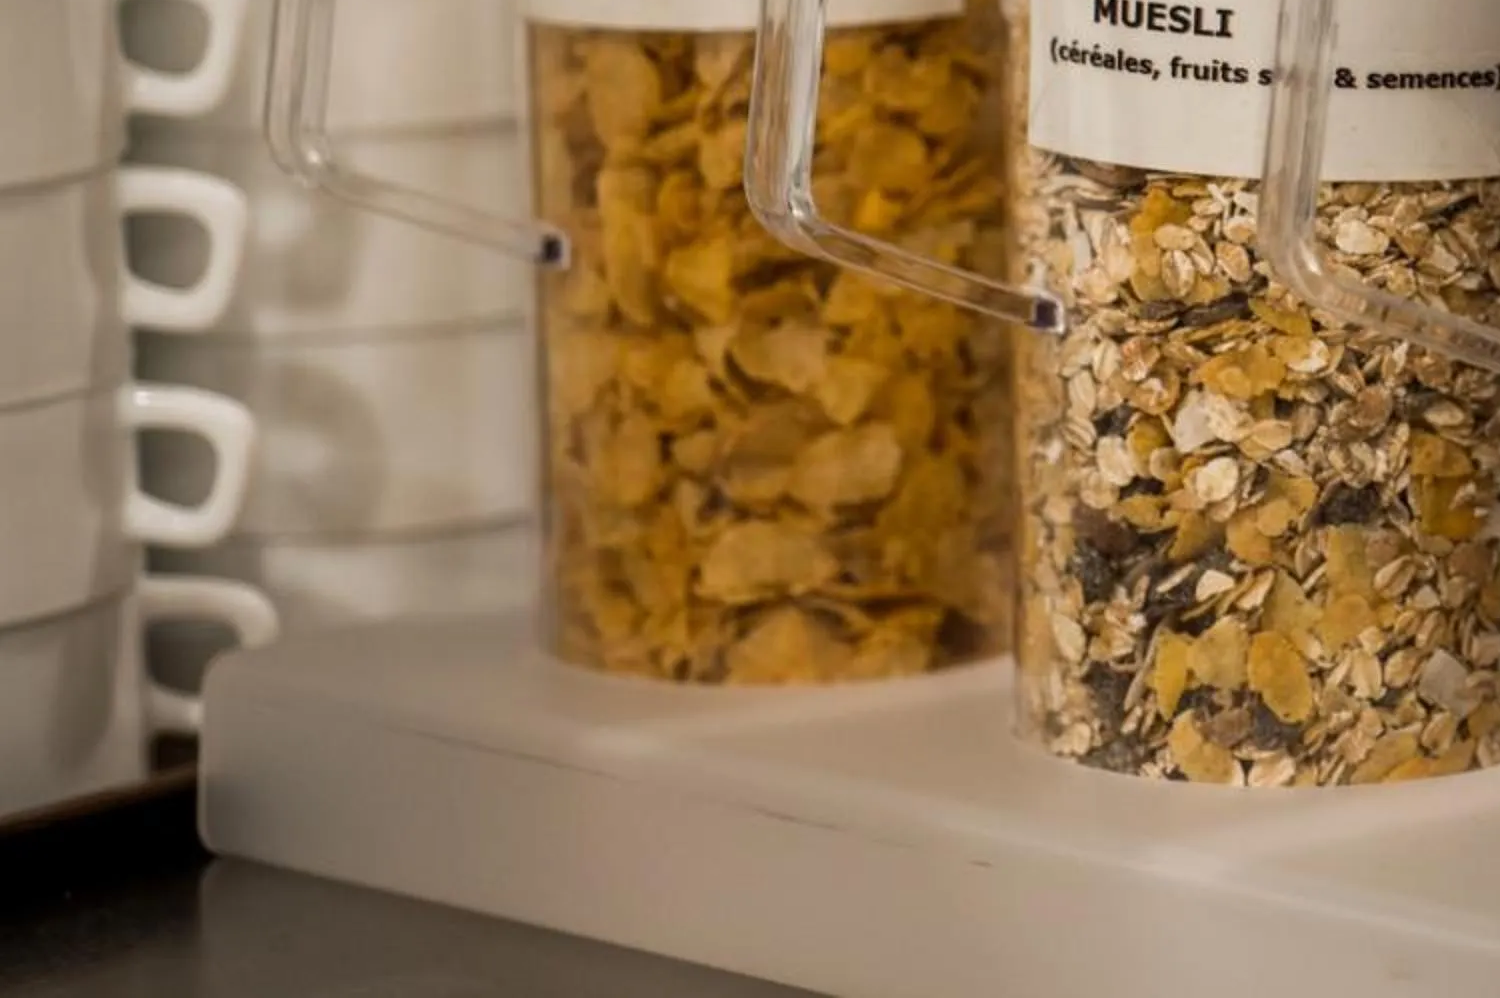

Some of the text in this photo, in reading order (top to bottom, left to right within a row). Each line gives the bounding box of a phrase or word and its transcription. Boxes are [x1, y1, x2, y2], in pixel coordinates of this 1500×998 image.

[1049, 36, 1161, 82] (céréales,
[1170, 55, 1250, 85] fruits
[1333, 66, 1357, 90] &
